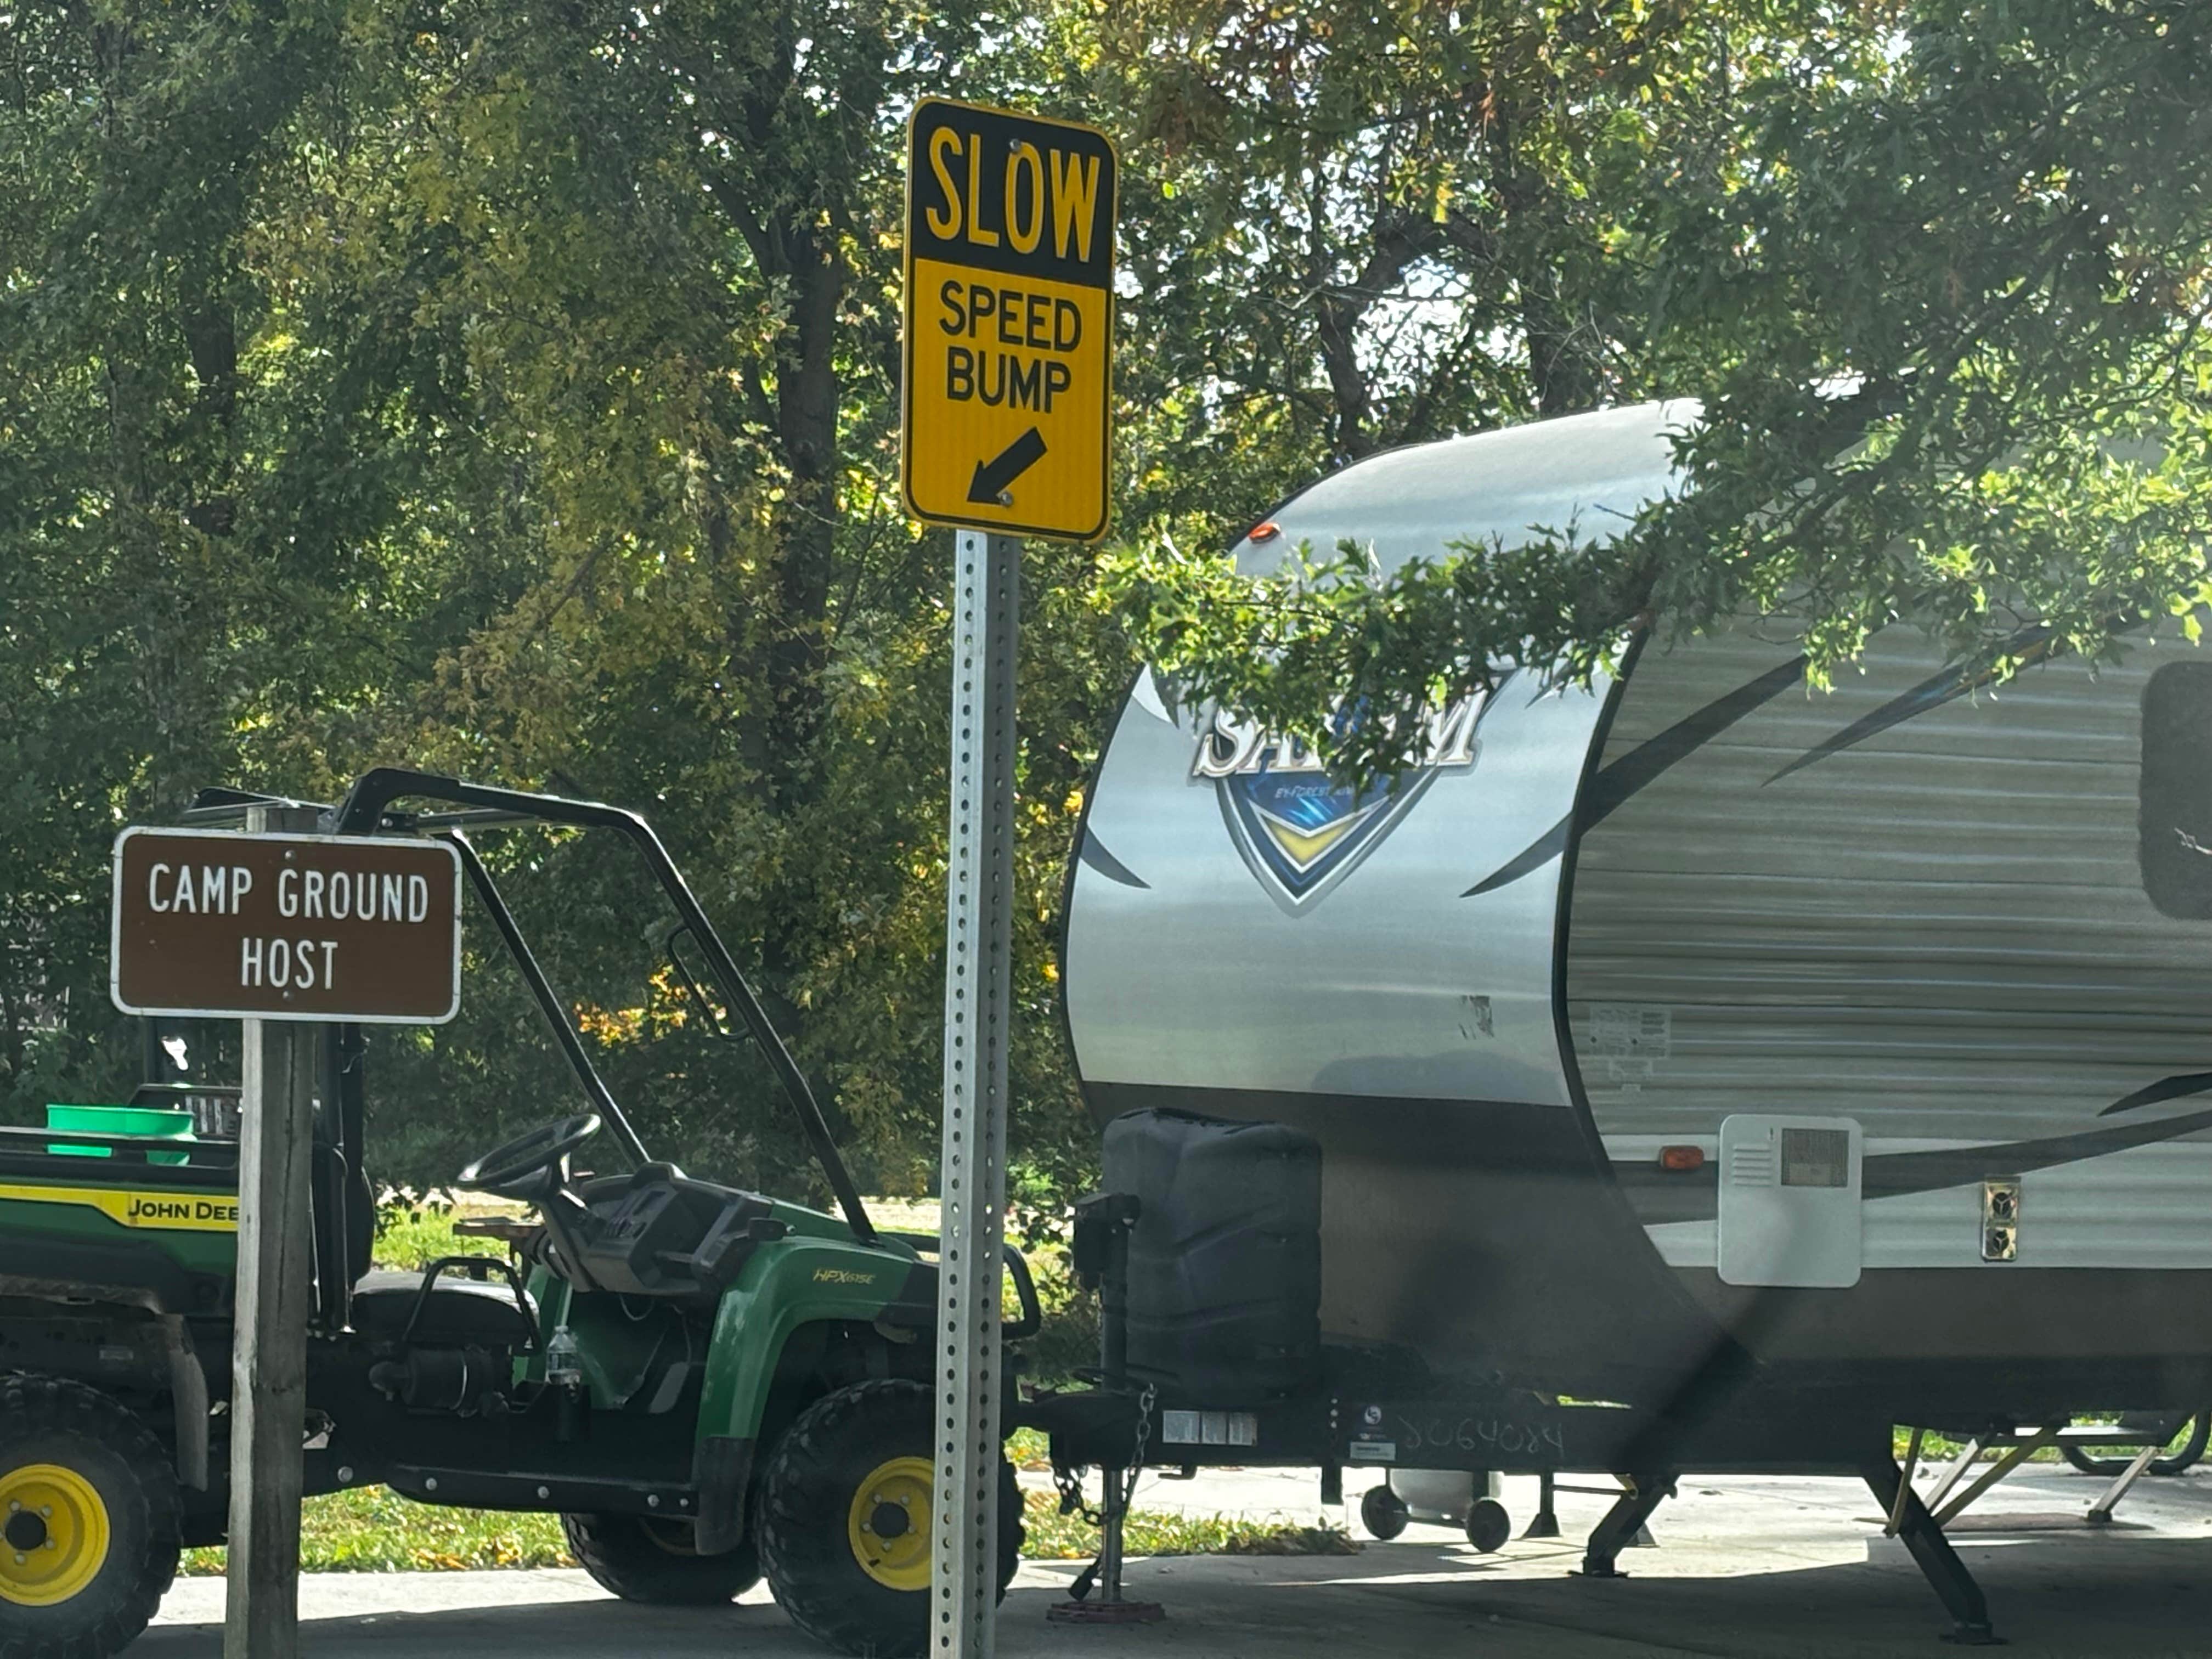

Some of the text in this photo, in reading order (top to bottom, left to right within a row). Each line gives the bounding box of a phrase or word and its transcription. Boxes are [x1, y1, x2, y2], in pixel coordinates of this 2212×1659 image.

[926, 127, 1100, 263] SLOW
[939, 279, 1082, 352] SPEED
[947, 346, 1071, 414] BUMP
[149, 863, 428, 923] CAMP GROUND
[241, 938, 338, 990] HOST
[128, 1199, 239, 1221] JOHN DEE
